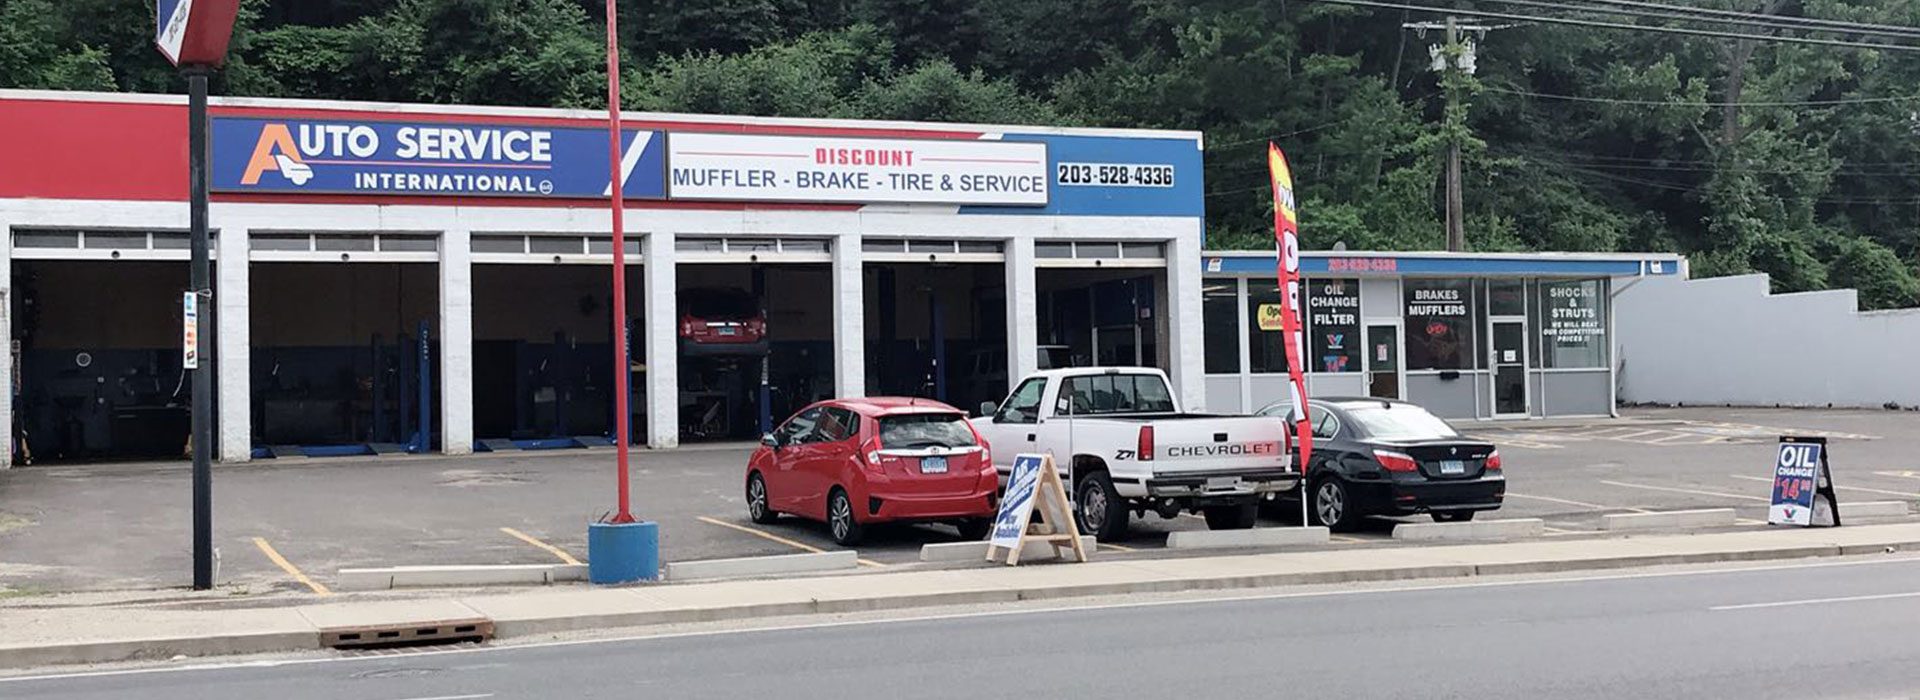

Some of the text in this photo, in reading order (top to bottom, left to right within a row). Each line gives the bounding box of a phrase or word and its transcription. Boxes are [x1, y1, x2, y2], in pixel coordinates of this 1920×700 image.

[240, 123, 552, 185] AUTO SERVICE
[815, 148, 914, 167] DISCOUNT
[673, 168, 777, 188] MUFFLER
[796, 171, 869, 190] BRAKE
[889, 173, 934, 191] TIRE
[940, 174, 954, 192] &
[960, 174, 1044, 193] SERVICE
[1059, 165, 1173, 185] 203-528-4336
[354, 172, 536, 192] INTERNATIONAL
[1324, 284, 1344, 295] OIL
[1415, 289, 1459, 300] BRAKES
[1550, 287, 1596, 297] SHOCKS
[1311, 297, 1358, 307] CHANGE
[1568, 298, 1577, 308] &
[1409, 304, 1466, 316] MUFFLERS
[1552, 308, 1595, 318] STRUTS
[1314, 313, 1355, 325] FILTER
[1168, 443, 1273, 457] CHEVROLET
[1780, 446, 1815, 468] OIL
[1778, 466, 1813, 476] CHANGE
